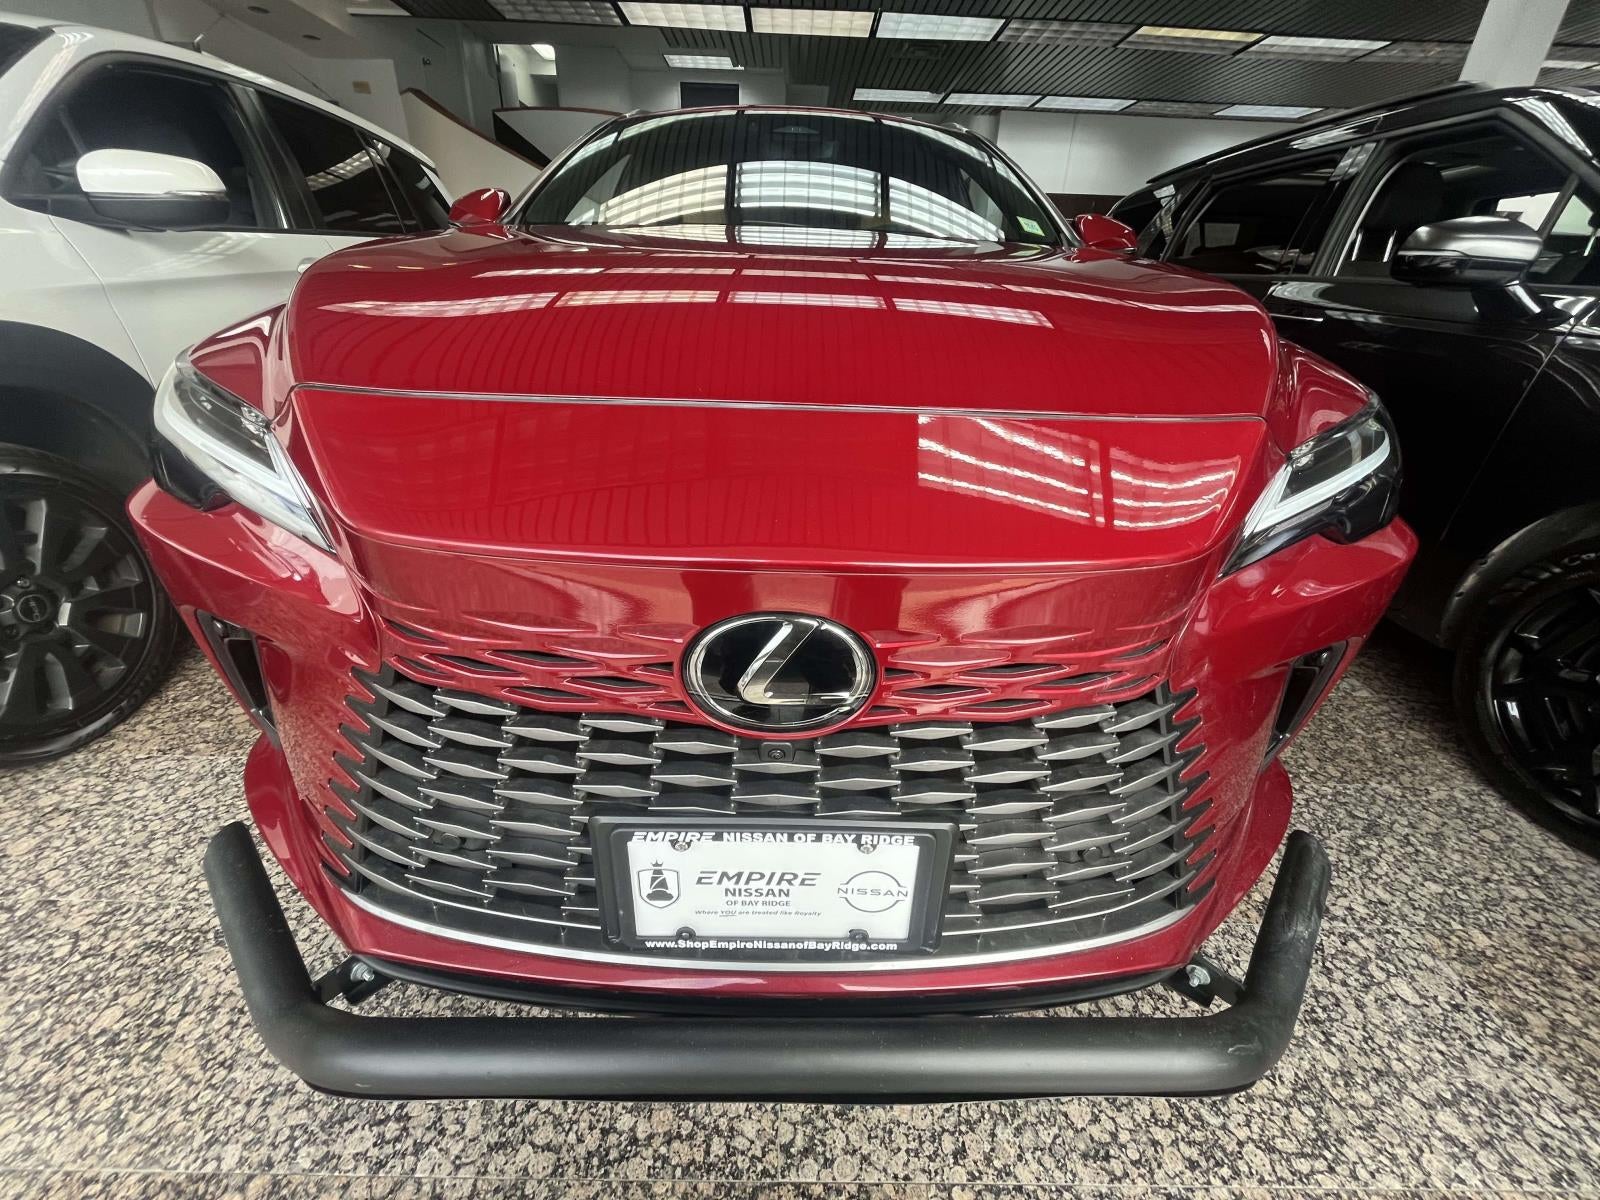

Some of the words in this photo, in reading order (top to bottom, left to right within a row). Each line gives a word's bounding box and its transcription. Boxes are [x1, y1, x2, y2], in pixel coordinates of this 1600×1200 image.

[632, 831, 716, 843] EMPIRE
[722, 832, 788, 844] NISSAN
[793, 833, 818, 844] OF
[821, 834, 856, 845] BAY
[860, 835, 915, 846] RIDGE
[696, 870, 822, 887] EMPIRE
[724, 887, 791, 898] NISSAN
[837, 887, 909, 898] NISSAN
[761, 900, 791, 908] RIDGE
[644, 940, 898, 951] www.ShopEmpireNissanofBayRidge.com
